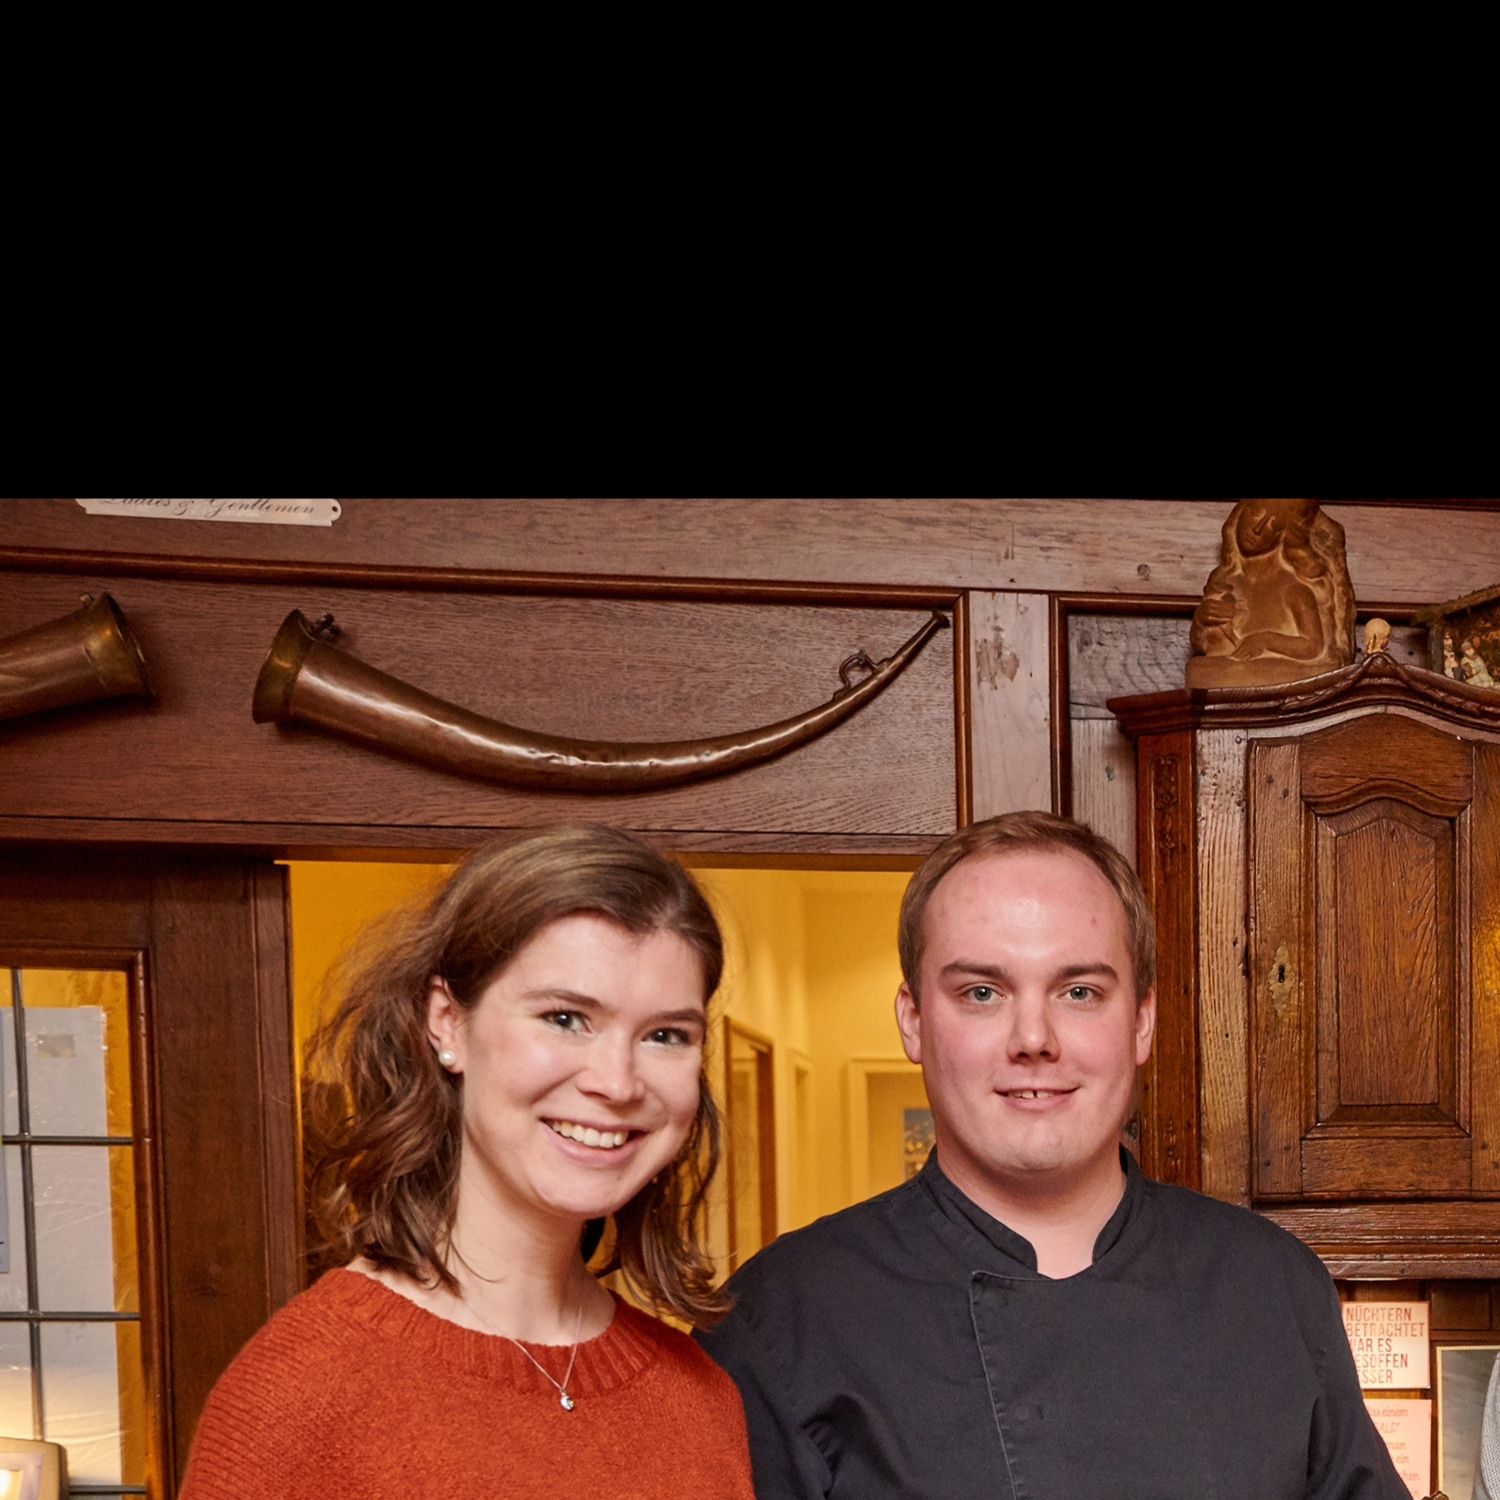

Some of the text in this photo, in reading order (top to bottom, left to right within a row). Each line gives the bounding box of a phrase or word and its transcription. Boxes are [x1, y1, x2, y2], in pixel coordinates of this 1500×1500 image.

[1346, 1305, 1412, 1321] NÜCHTERN
[1346, 1323, 1425, 1337] BETRACHTET
[1377, 1338, 1393, 1352] ES
[1354, 1353, 1409, 1369] ESOFFEN
[1357, 1369, 1393, 1384] SSER
